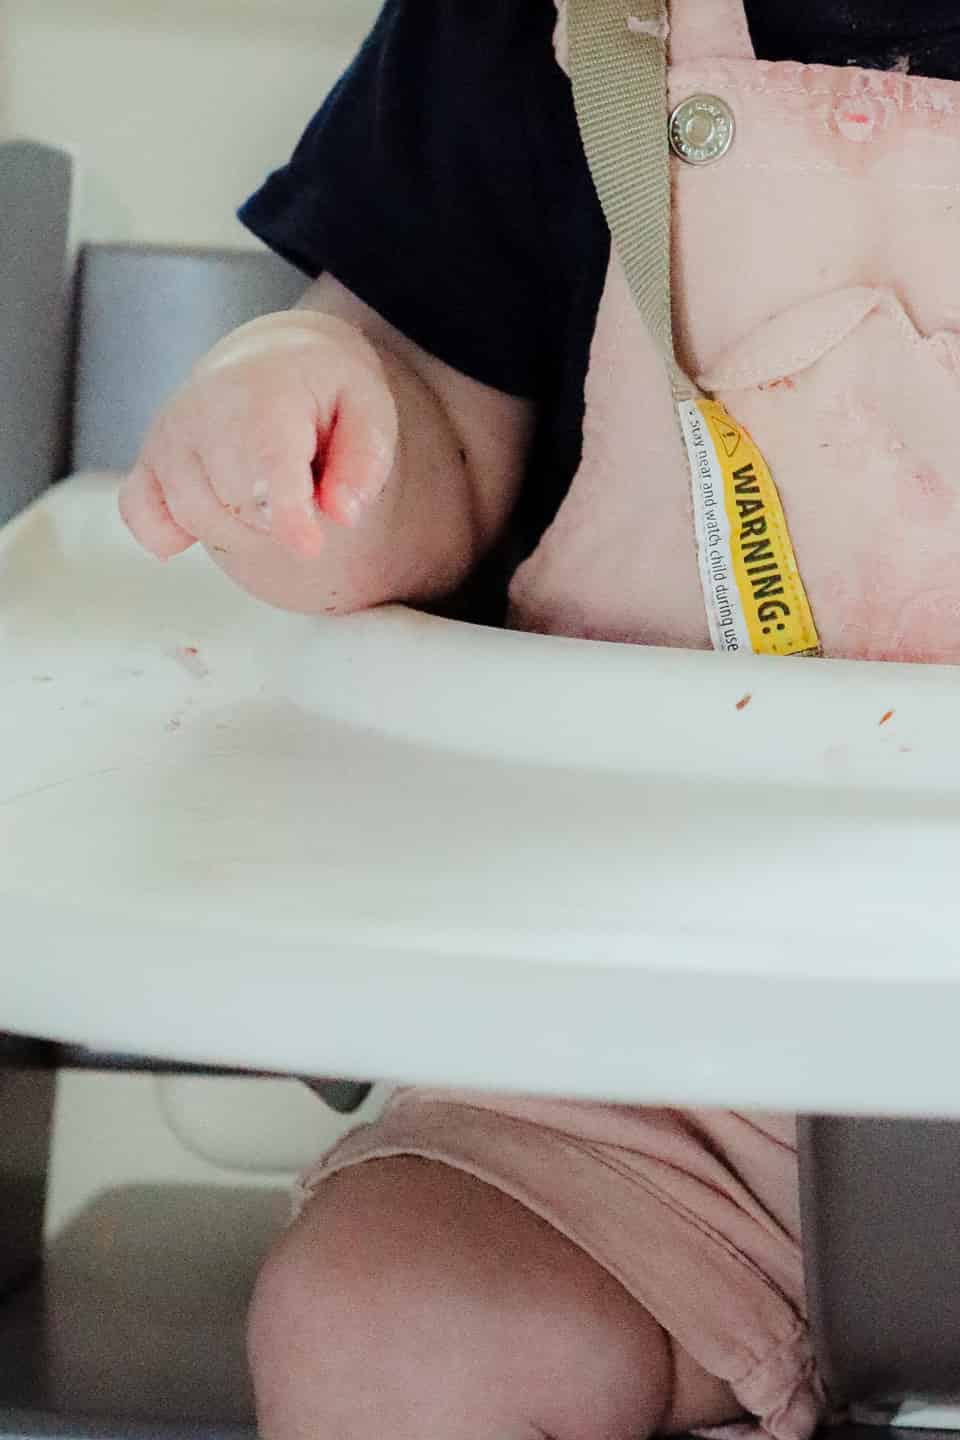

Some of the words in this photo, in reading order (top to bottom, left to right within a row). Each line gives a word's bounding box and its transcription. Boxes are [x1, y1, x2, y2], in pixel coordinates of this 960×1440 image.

[699, 450, 712, 478] near
[703, 482, 717, 508] and
[704, 509, 722, 547] watch
[732, 463, 791, 635] WARNING:
[710, 550, 727, 581] child
[715, 584, 734, 627] during
[724, 629, 738, 652] use
